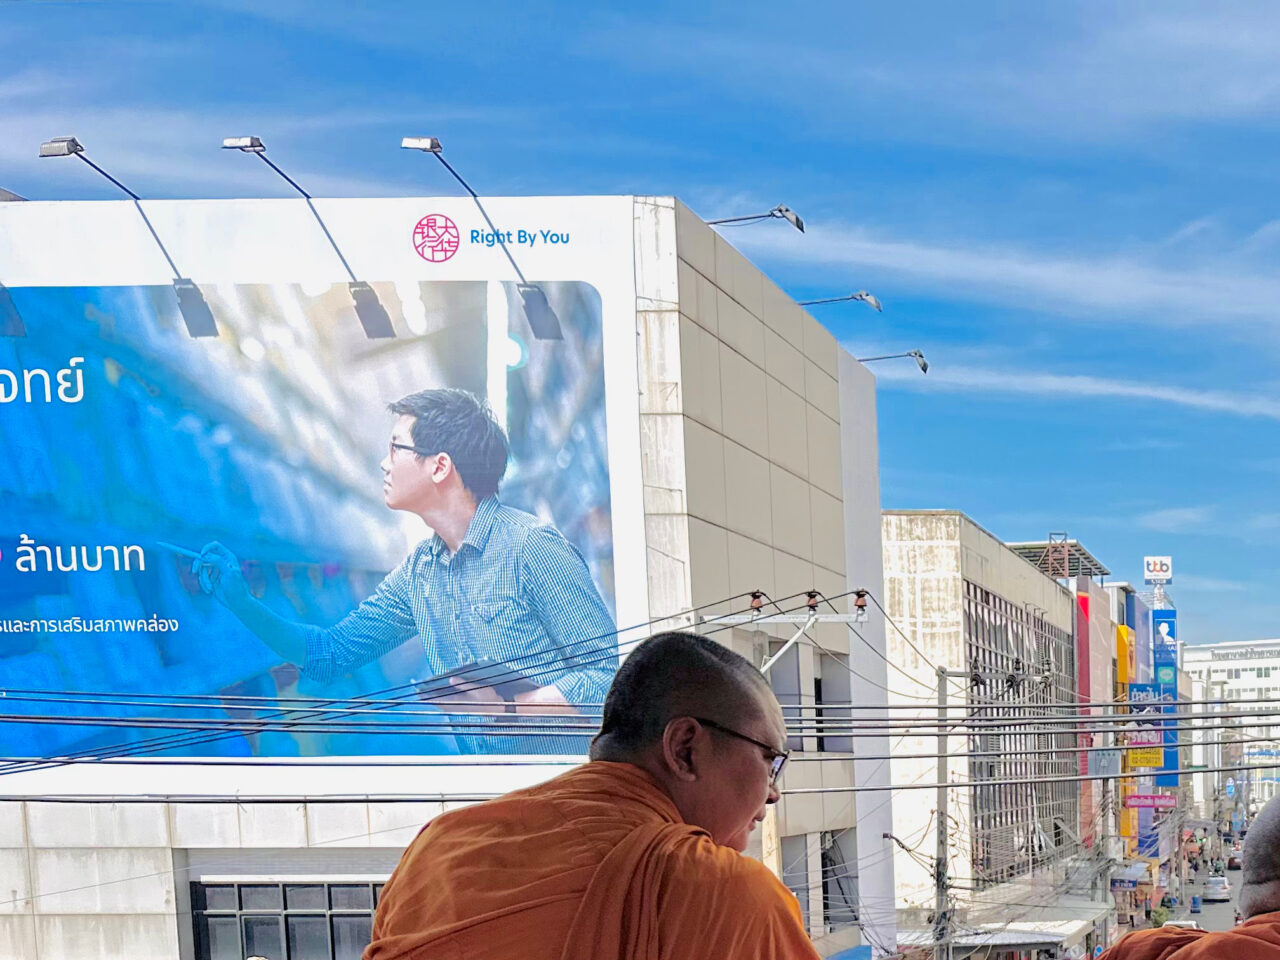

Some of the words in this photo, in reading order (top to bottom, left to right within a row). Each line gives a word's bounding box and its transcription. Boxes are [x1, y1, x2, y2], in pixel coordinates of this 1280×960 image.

[470, 229, 513, 248] Right
[517, 229, 537, 248] By
[540, 229, 570, 245] You
[15, 533, 146, 572] ล้านบาท
[1146, 560, 1170, 573] ttb
